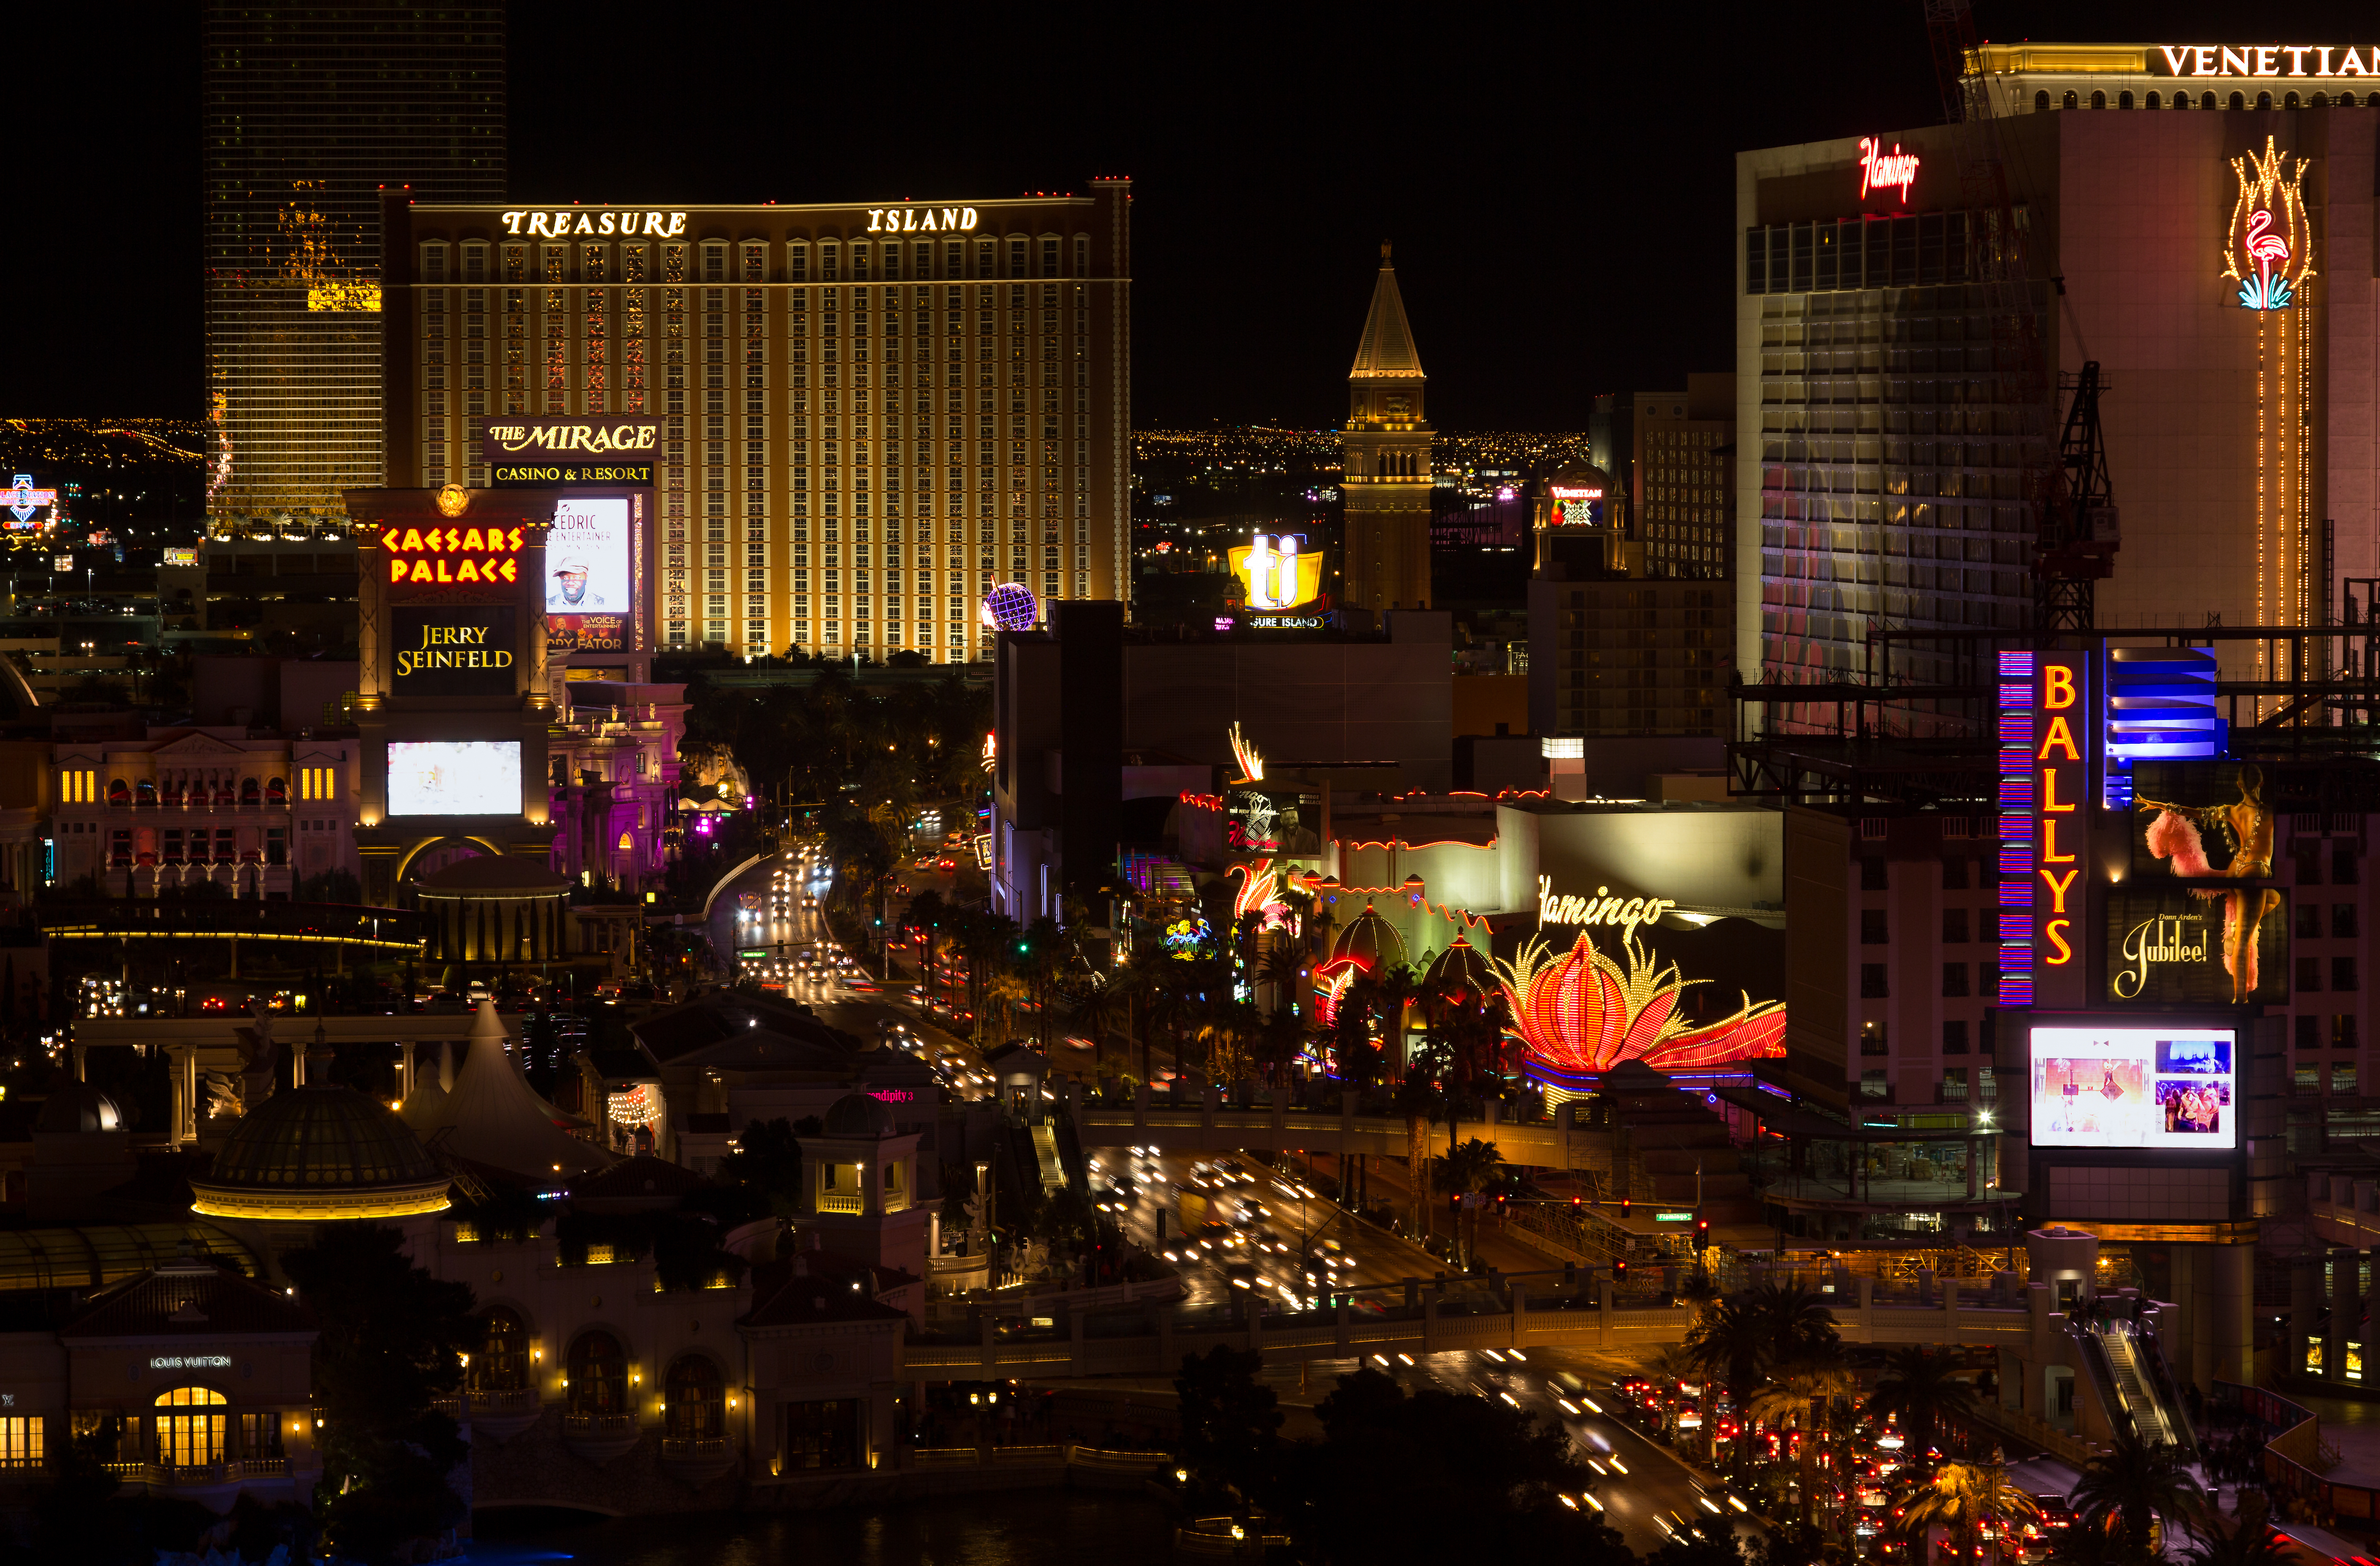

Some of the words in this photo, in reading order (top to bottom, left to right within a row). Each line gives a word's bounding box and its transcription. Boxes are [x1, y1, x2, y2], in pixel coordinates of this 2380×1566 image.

[1859, 137, 1920, 204] Flamingo
[501, 210, 687, 237] TREASURE
[867, 207, 977, 232] ISLAND
[489, 426, 525, 440] THE
[503, 425, 656, 453] MIRAGE
[496, 468, 559, 480] CASINO
[565, 469, 576, 480] &
[581, 468, 650, 480] RESORT
[1551, 487, 1602, 498] VENETIAN
[1562, 500, 1592, 516] ROCK
[554, 515, 596, 529] CEDRIC
[1562, 512, 1593, 526] AGES
[382, 527, 524, 552] CAESARS
[556, 532, 611, 541] ENTERTAINER
[391, 557, 517, 583] PALACE
[1250, 617, 1276, 627] SURE
[1282, 617, 1317, 627] ISLAND
[421, 625, 488, 650] JERRY
[578, 639, 622, 649] FATOR
[397, 650, 512, 675] SEINFELD
[2038, 665, 2080, 965] BALLYS
[1539, 874, 1676, 944] Flamingo
[2114, 918, 2207, 998] Jubilee!
[908, 1092, 913, 1100] 3
[151, 1358, 182, 1368] LOUIS
[184, 1356, 230, 1368] VUITTON
